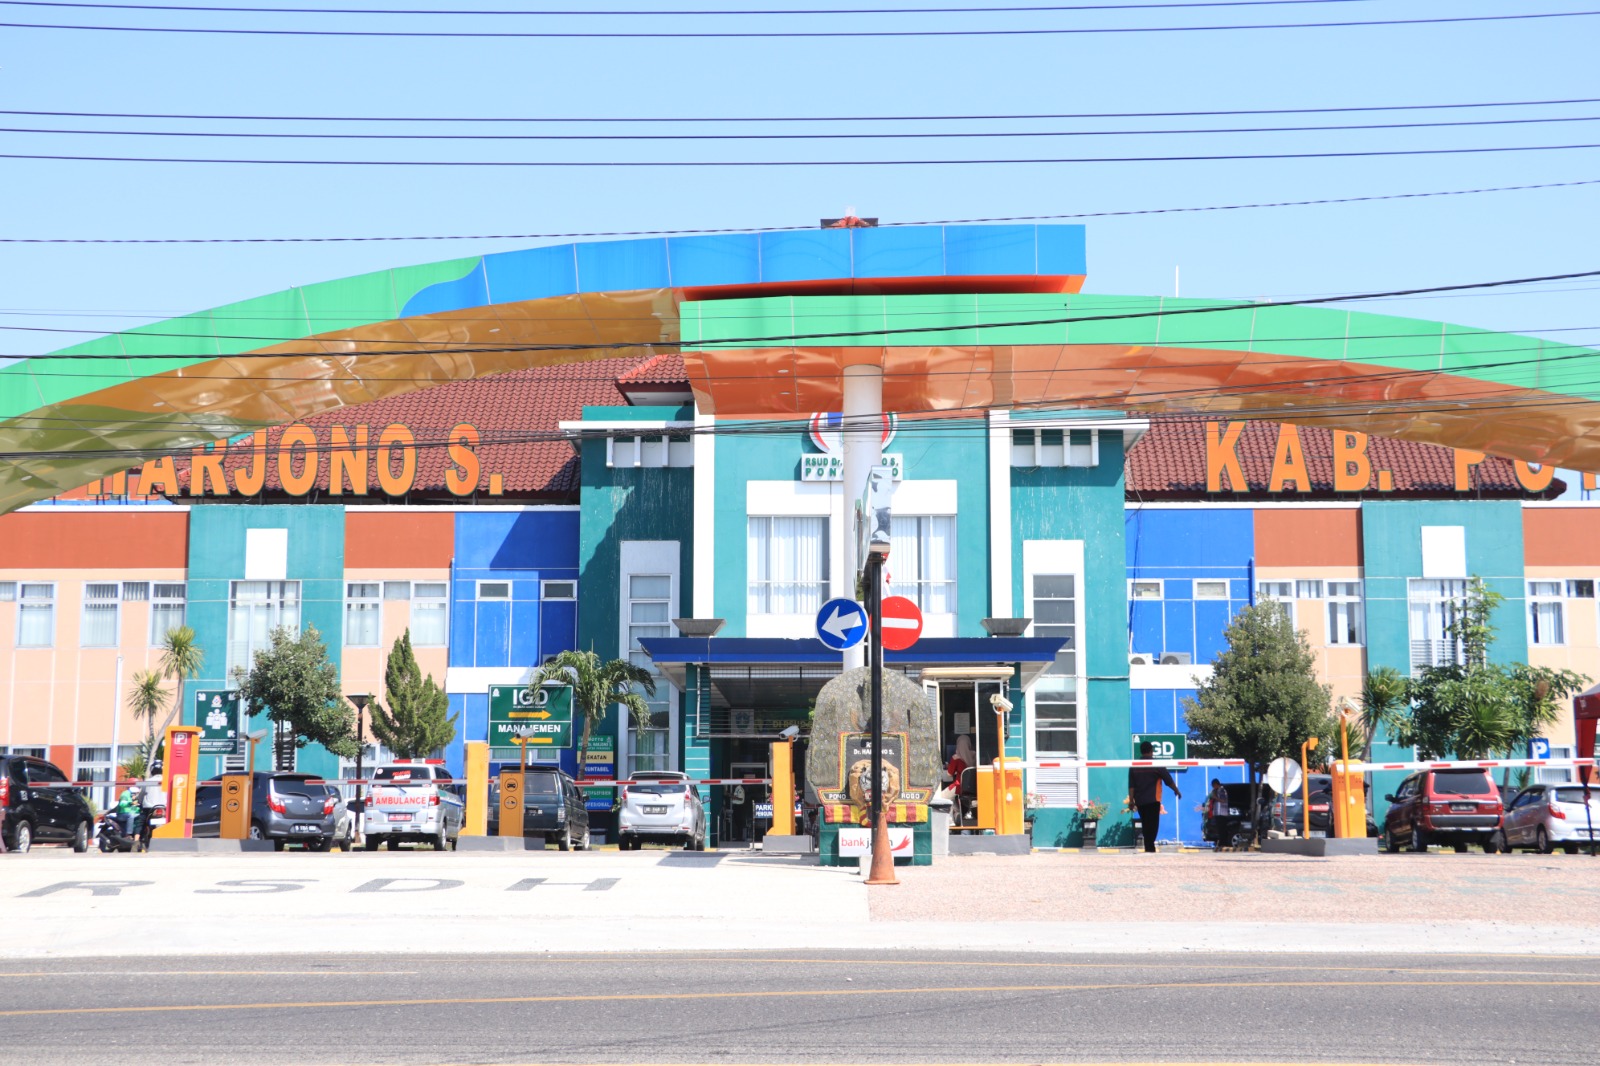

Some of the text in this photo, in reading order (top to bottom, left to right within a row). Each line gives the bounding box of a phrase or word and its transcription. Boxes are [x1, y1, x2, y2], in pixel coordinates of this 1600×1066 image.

[444, 422, 503, 496] S.
[805, 458, 828, 466] RSUD
[831, 458, 842, 466] Dr.
[1205, 421, 1393, 494] KAB.
[513, 689, 548, 705] IGD
[1151, 741, 1175, 756] GD
[1532, 741, 1548, 759] P
[375, 797, 427, 805] AMBULANCE
[841, 837, 866, 847] bank
